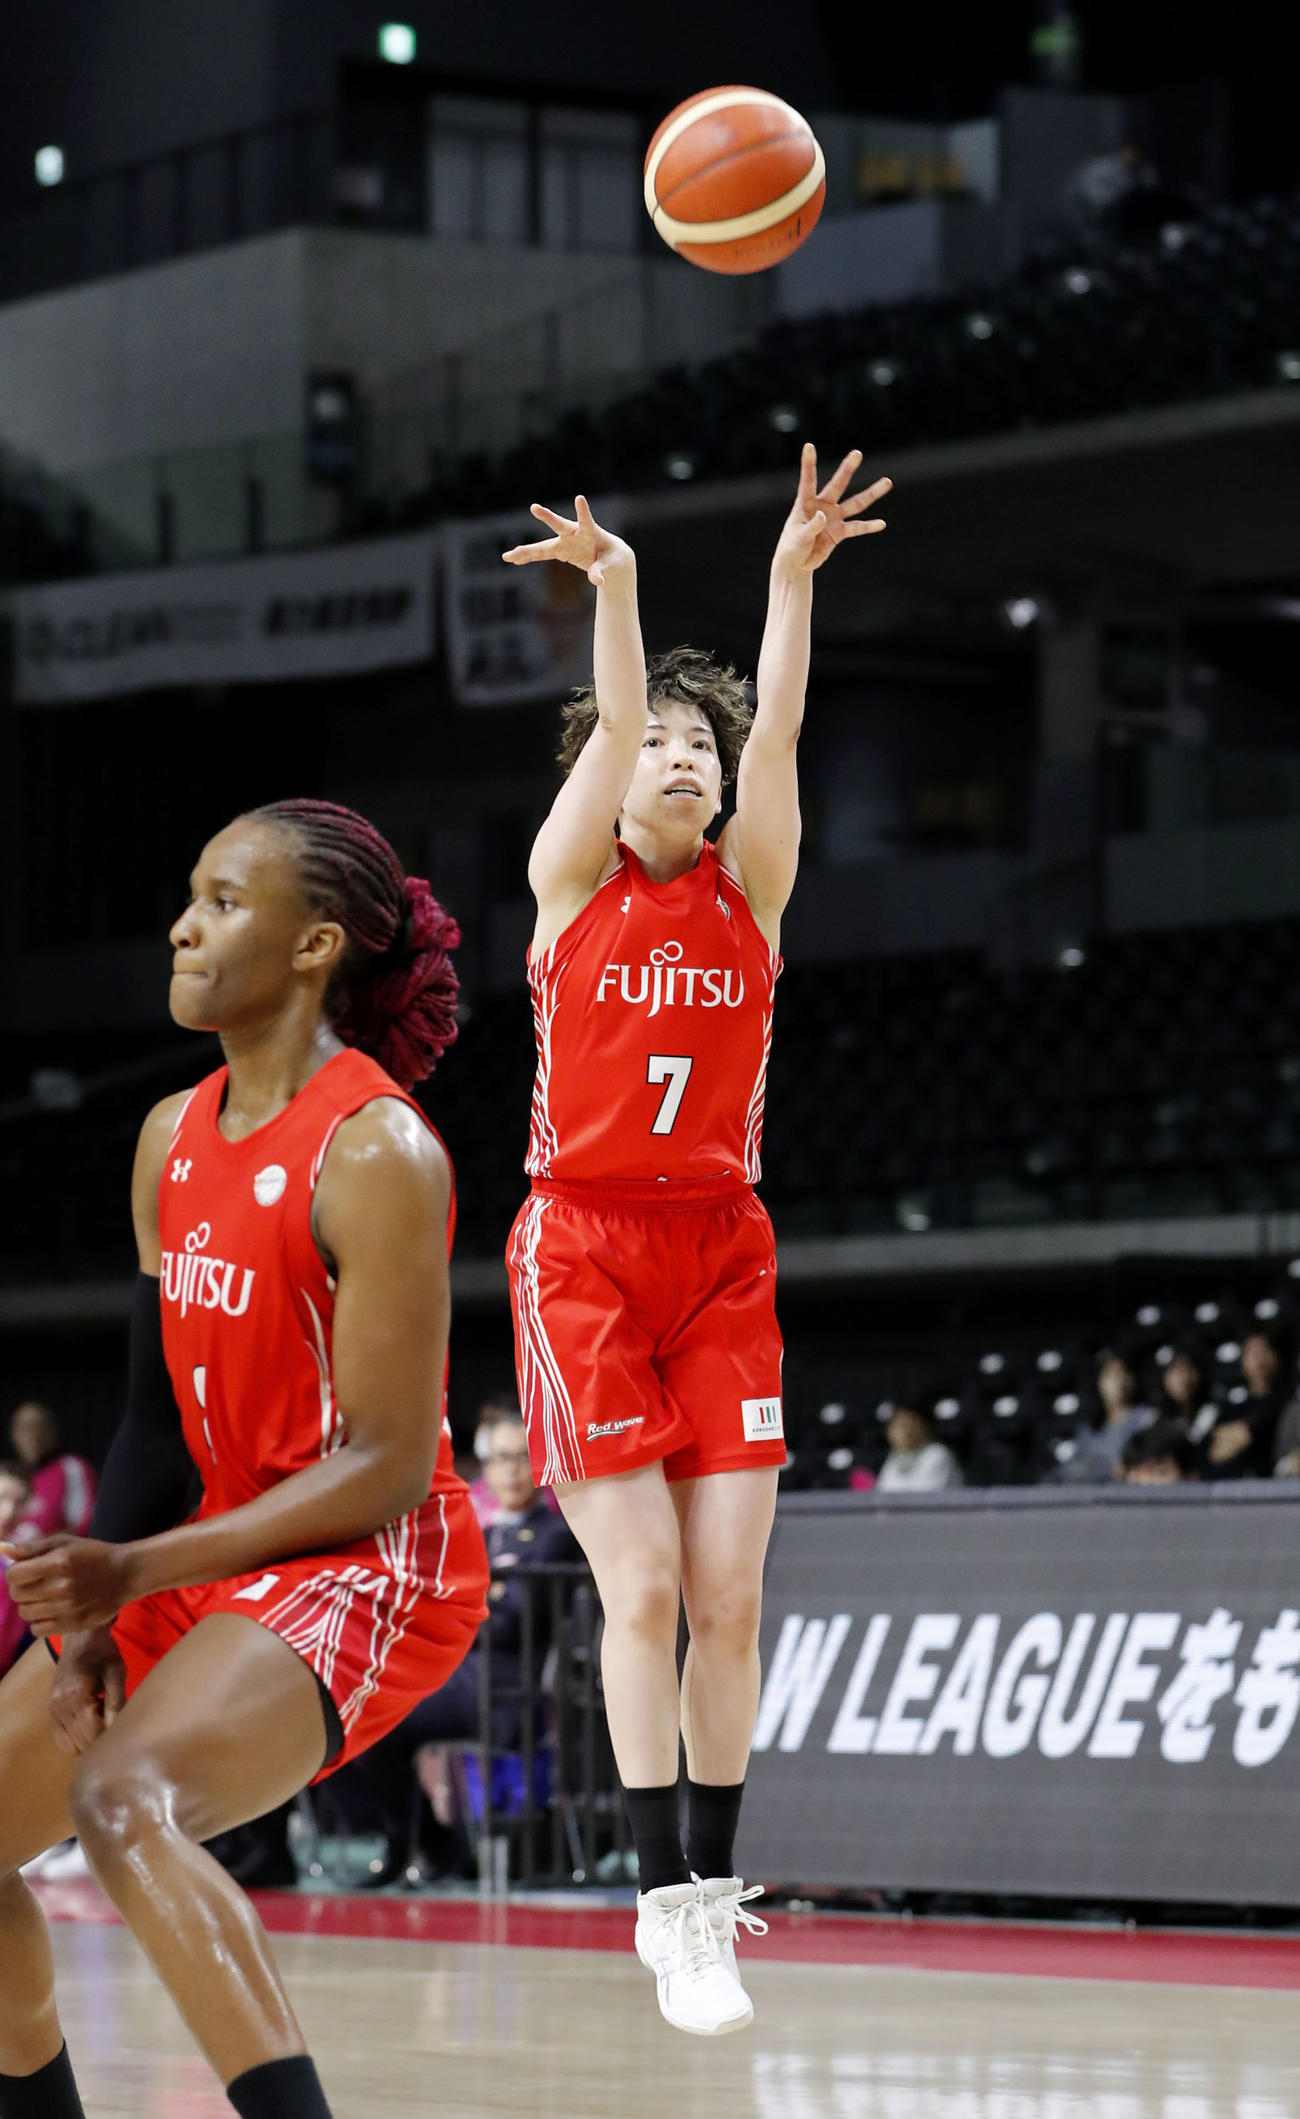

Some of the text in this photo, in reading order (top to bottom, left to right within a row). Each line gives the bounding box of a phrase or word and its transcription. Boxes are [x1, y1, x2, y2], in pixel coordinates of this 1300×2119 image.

[596, 962, 745, 1018] FUJITSU
[646, 1054, 693, 1135] 7
[160, 1250, 256, 1319] FUJITSU
[587, 1416, 645, 1435] Red Wave
[751, 1612, 851, 1753] W
